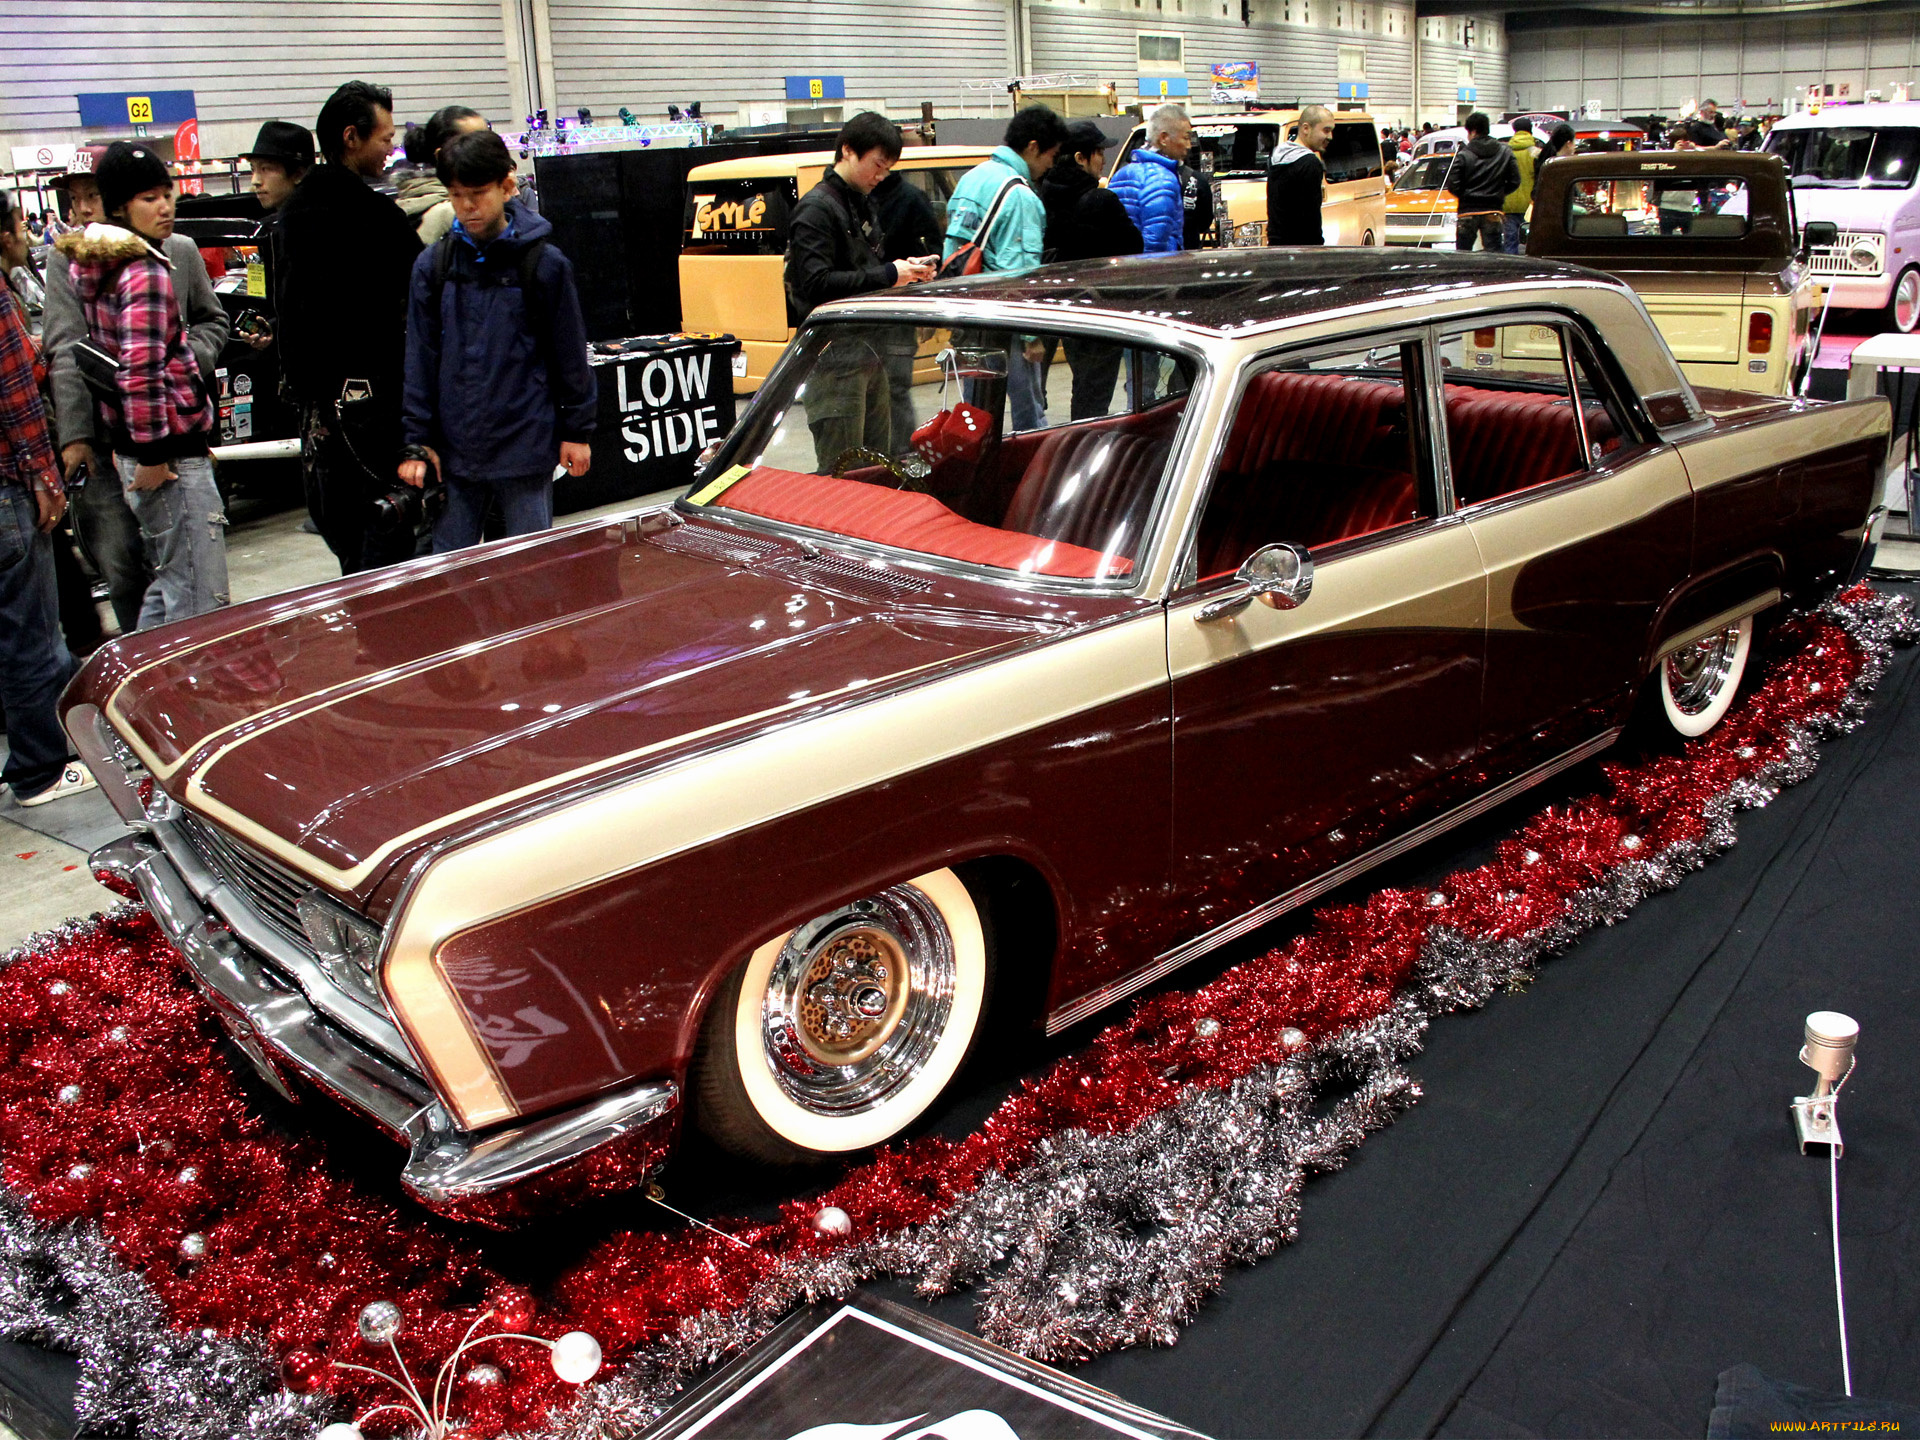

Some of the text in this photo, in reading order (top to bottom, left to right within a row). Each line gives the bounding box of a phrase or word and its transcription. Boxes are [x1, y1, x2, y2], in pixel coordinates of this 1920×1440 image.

[811, 83, 821, 95] G3
[131, 102, 149, 118] G2
[616, 353, 712, 413] LOW
[621, 405, 722, 463] SIDE
